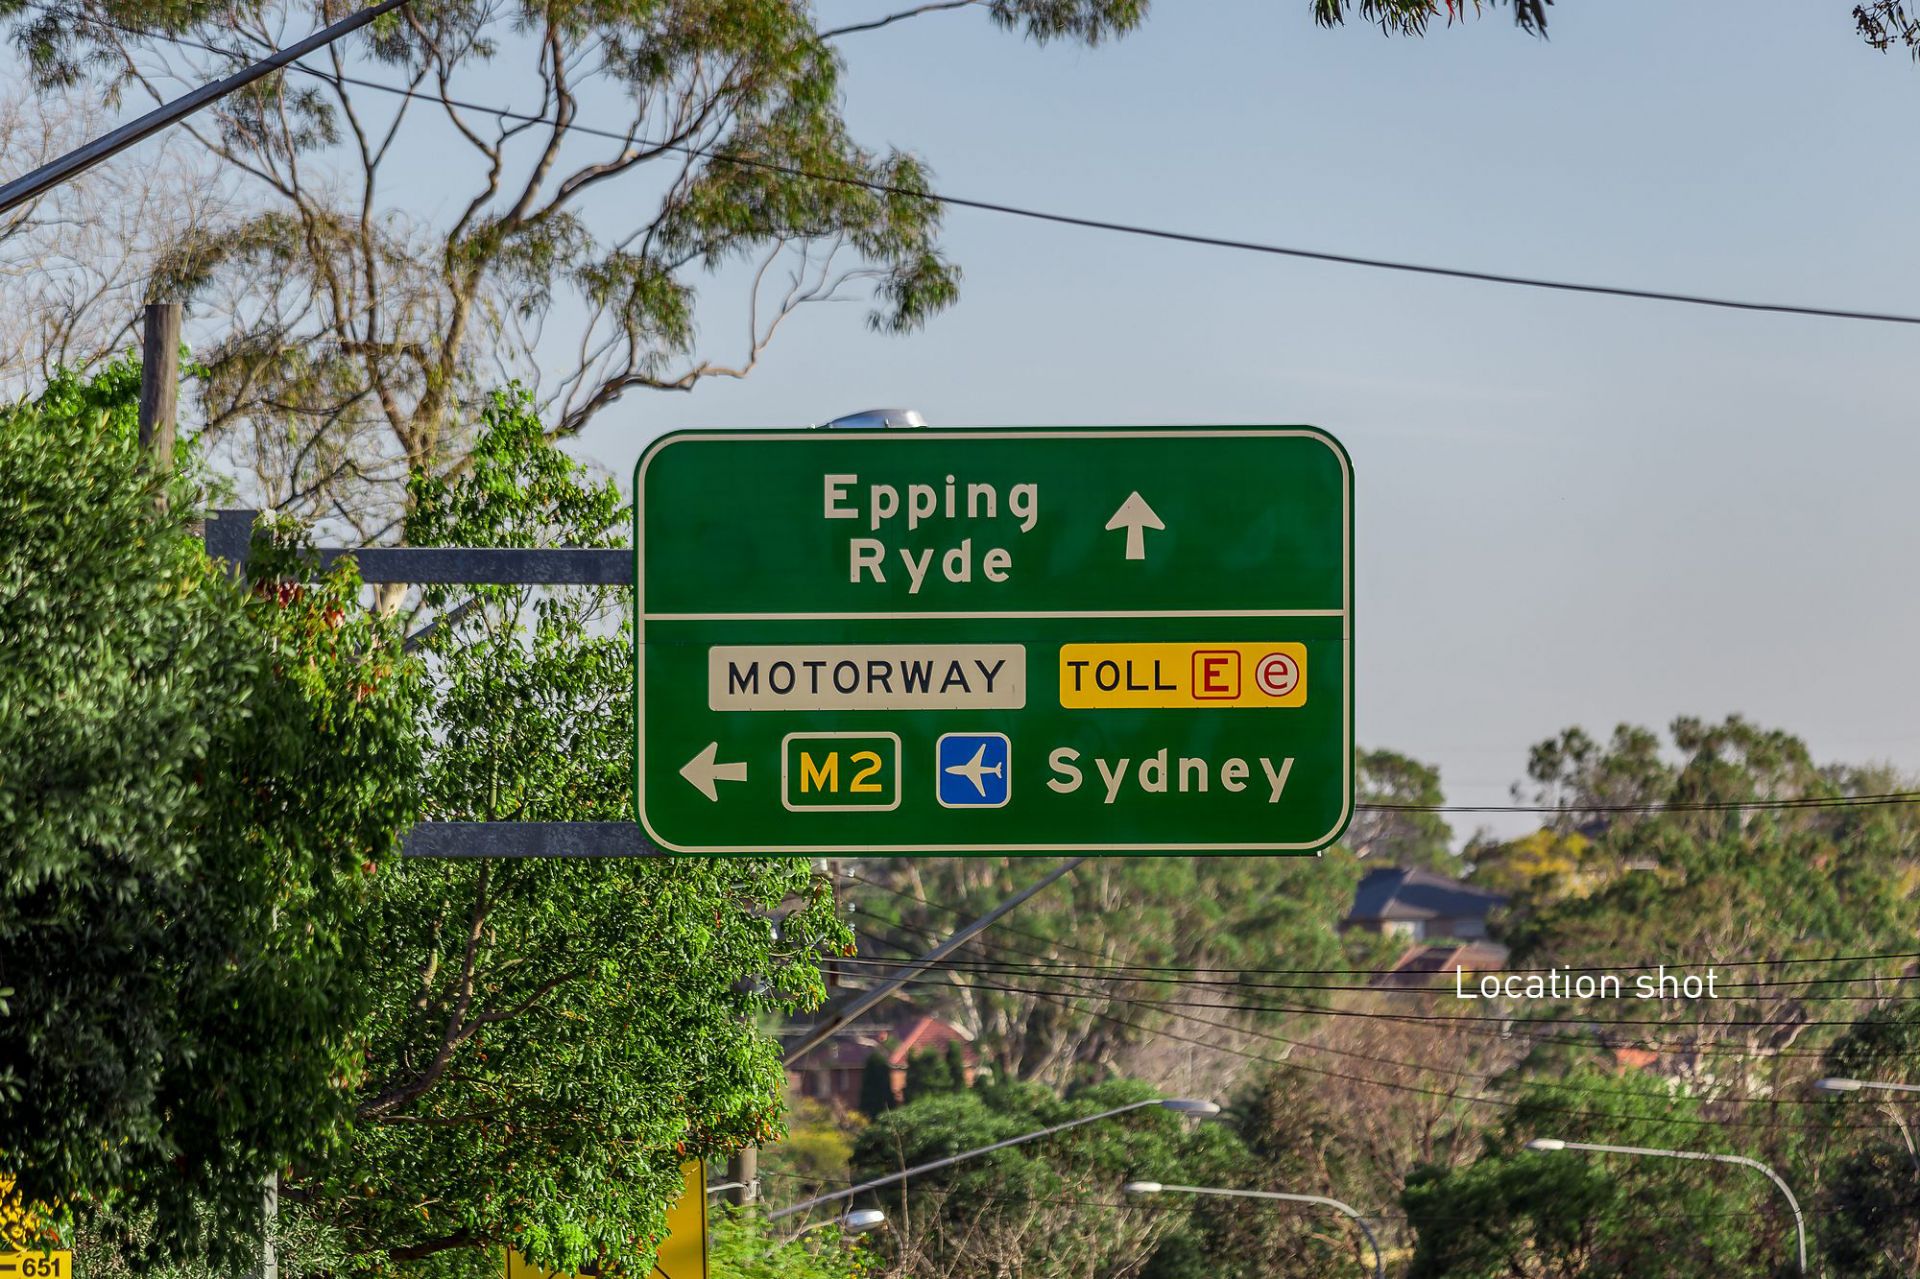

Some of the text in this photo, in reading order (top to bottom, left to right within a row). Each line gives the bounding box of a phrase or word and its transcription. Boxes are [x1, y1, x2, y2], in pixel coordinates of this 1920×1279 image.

[823, 473, 1038, 533] Epping
[849, 537, 1012, 594] Ryde
[727, 659, 1006, 696] MOTORWAY
[1067, 659, 1177, 692] TOLL
[1201, 657, 1229, 693] E
[800, 750, 884, 793] M2
[1046, 746, 1295, 804] Sydney
